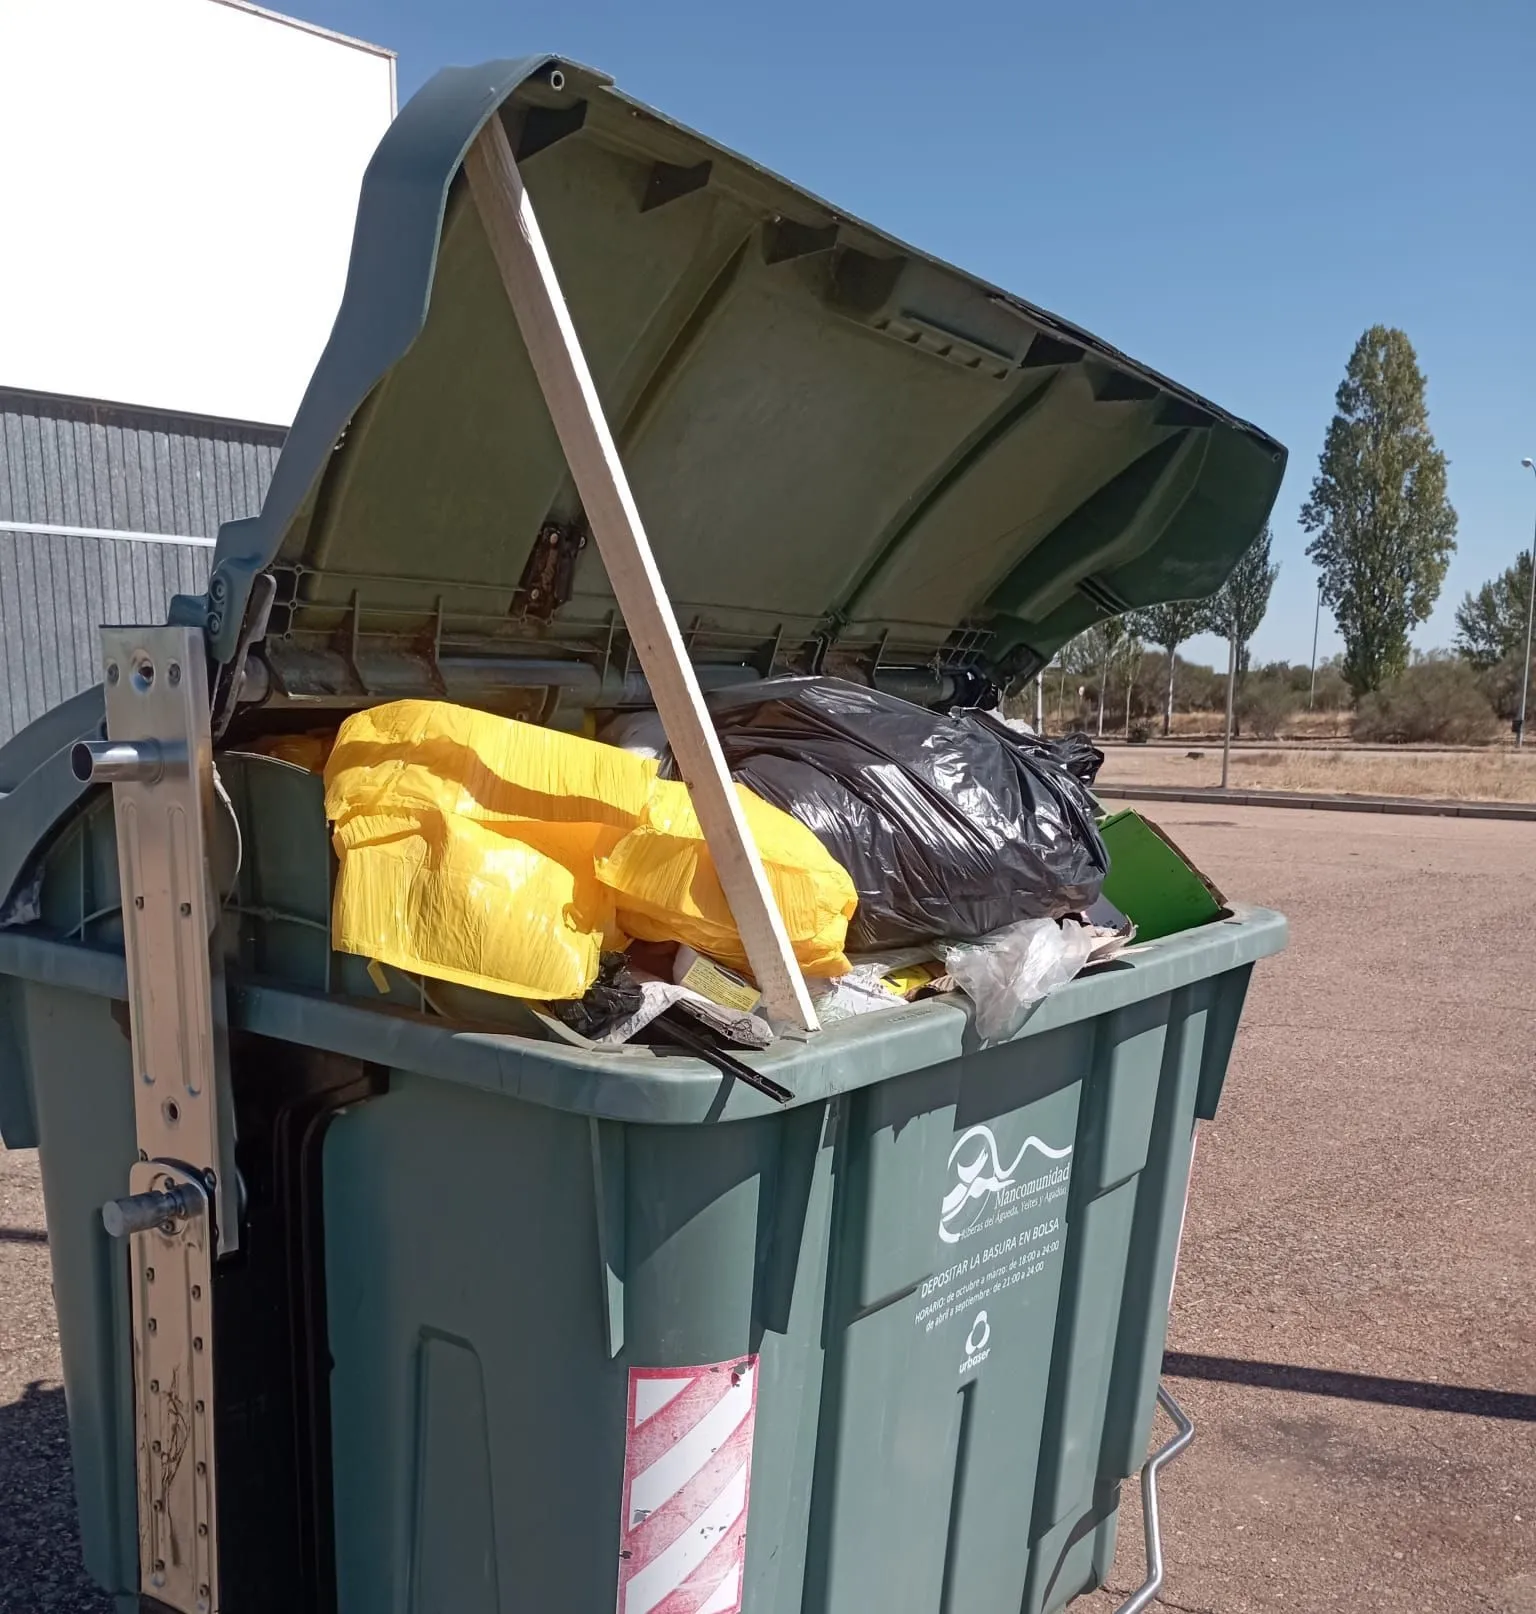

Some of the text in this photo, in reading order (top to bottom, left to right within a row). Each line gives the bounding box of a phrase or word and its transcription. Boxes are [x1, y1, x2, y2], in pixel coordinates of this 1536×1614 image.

[984, 1216, 996, 1228] del
[1038, 1196, 1044, 1208] y
[994, 1162, 1071, 1209] Mancomunidad
[915, 1297, 947, 1325] HORARIO:
[946, 1291, 955, 1303] de
[955, 1277, 980, 1300] octubre
[986, 1264, 1008, 1281] marzo:
[1008, 1258, 1017, 1271] de
[1018, 1249, 1036, 1266] 18:00
[1041, 1240, 1060, 1256] 24:00
[921, 1217, 1060, 1298] DEPOSITAR LA BASURA EN BOLSA
[925, 1320, 934, 1333] de
[934, 1309, 950, 1328] abril
[992, 1281, 1001, 1293] de
[1001, 1270, 1021, 1289] 21:00
[1026, 1260, 1045, 1277] 24:00
[959, 1347, 991, 1374] urbaser
